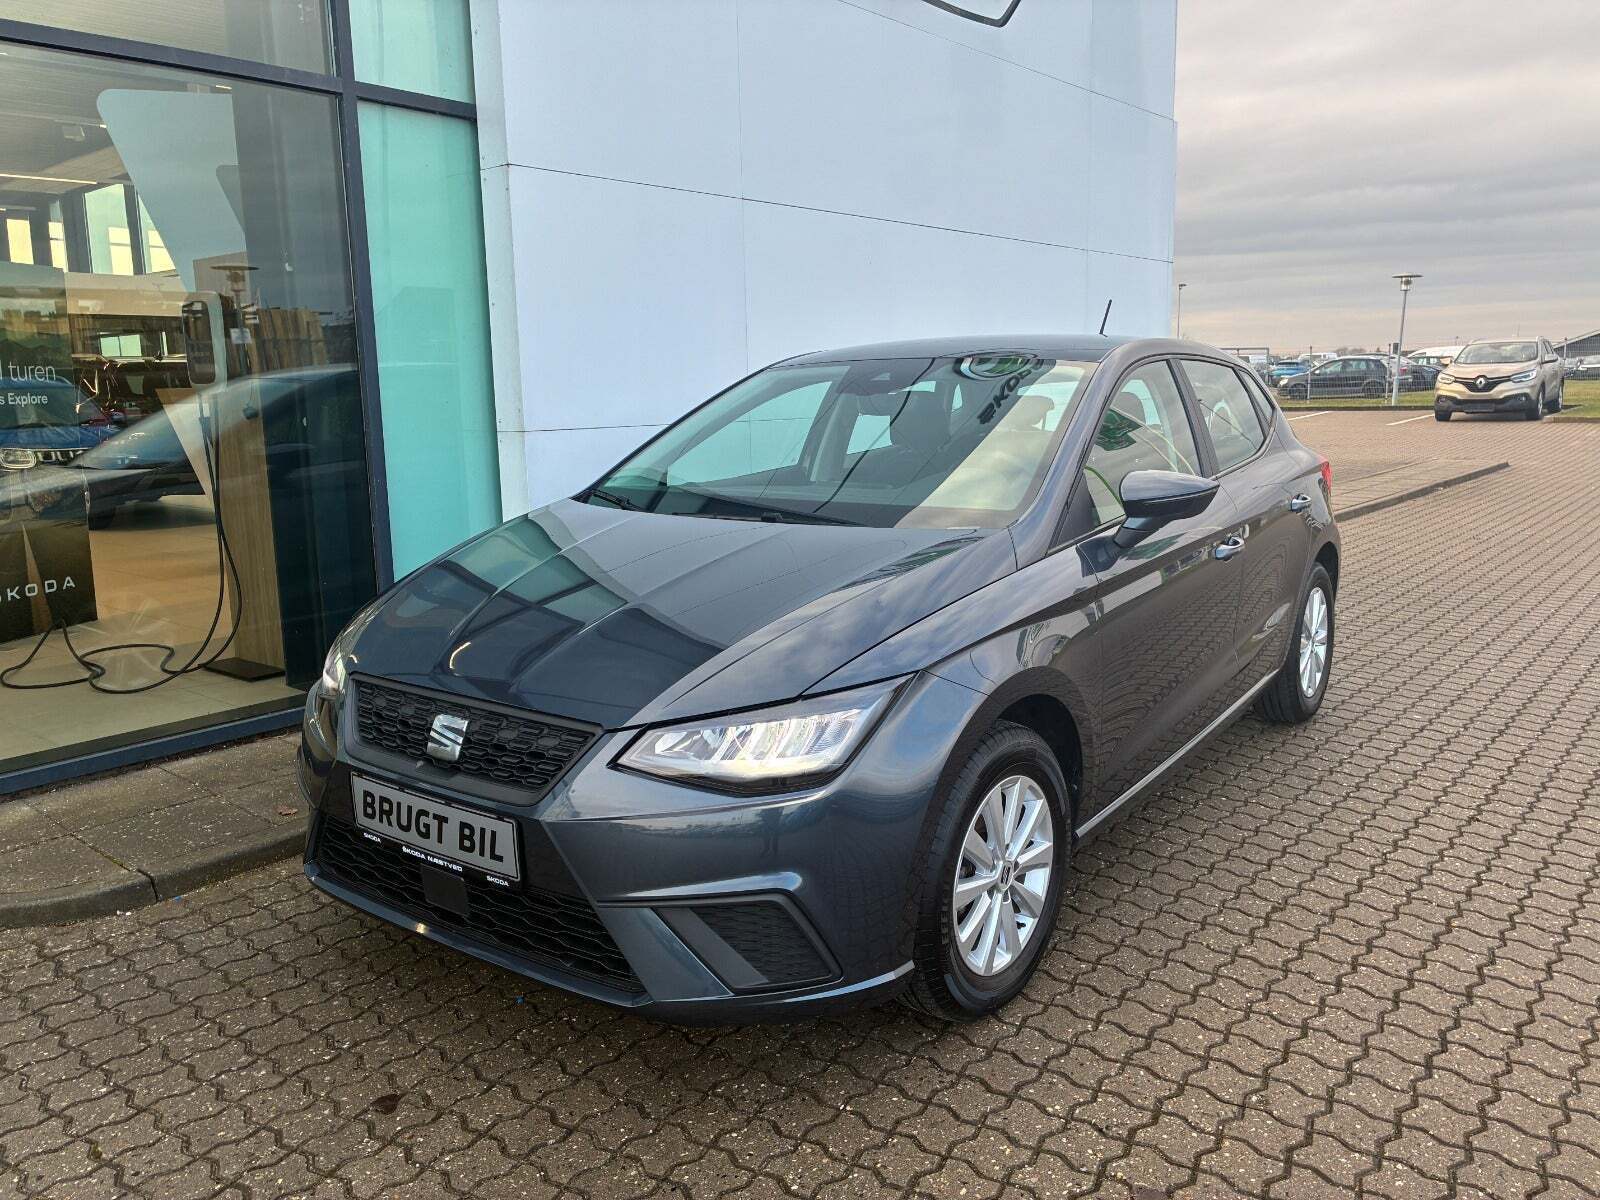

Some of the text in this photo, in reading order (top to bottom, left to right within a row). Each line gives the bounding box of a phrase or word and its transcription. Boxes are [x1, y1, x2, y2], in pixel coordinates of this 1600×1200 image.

[8, 361, 56, 381] turen
[8, 392, 48, 407] Explore
[0, 576, 76, 602] KODA
[362, 789, 504, 863] BRUGT BIL
